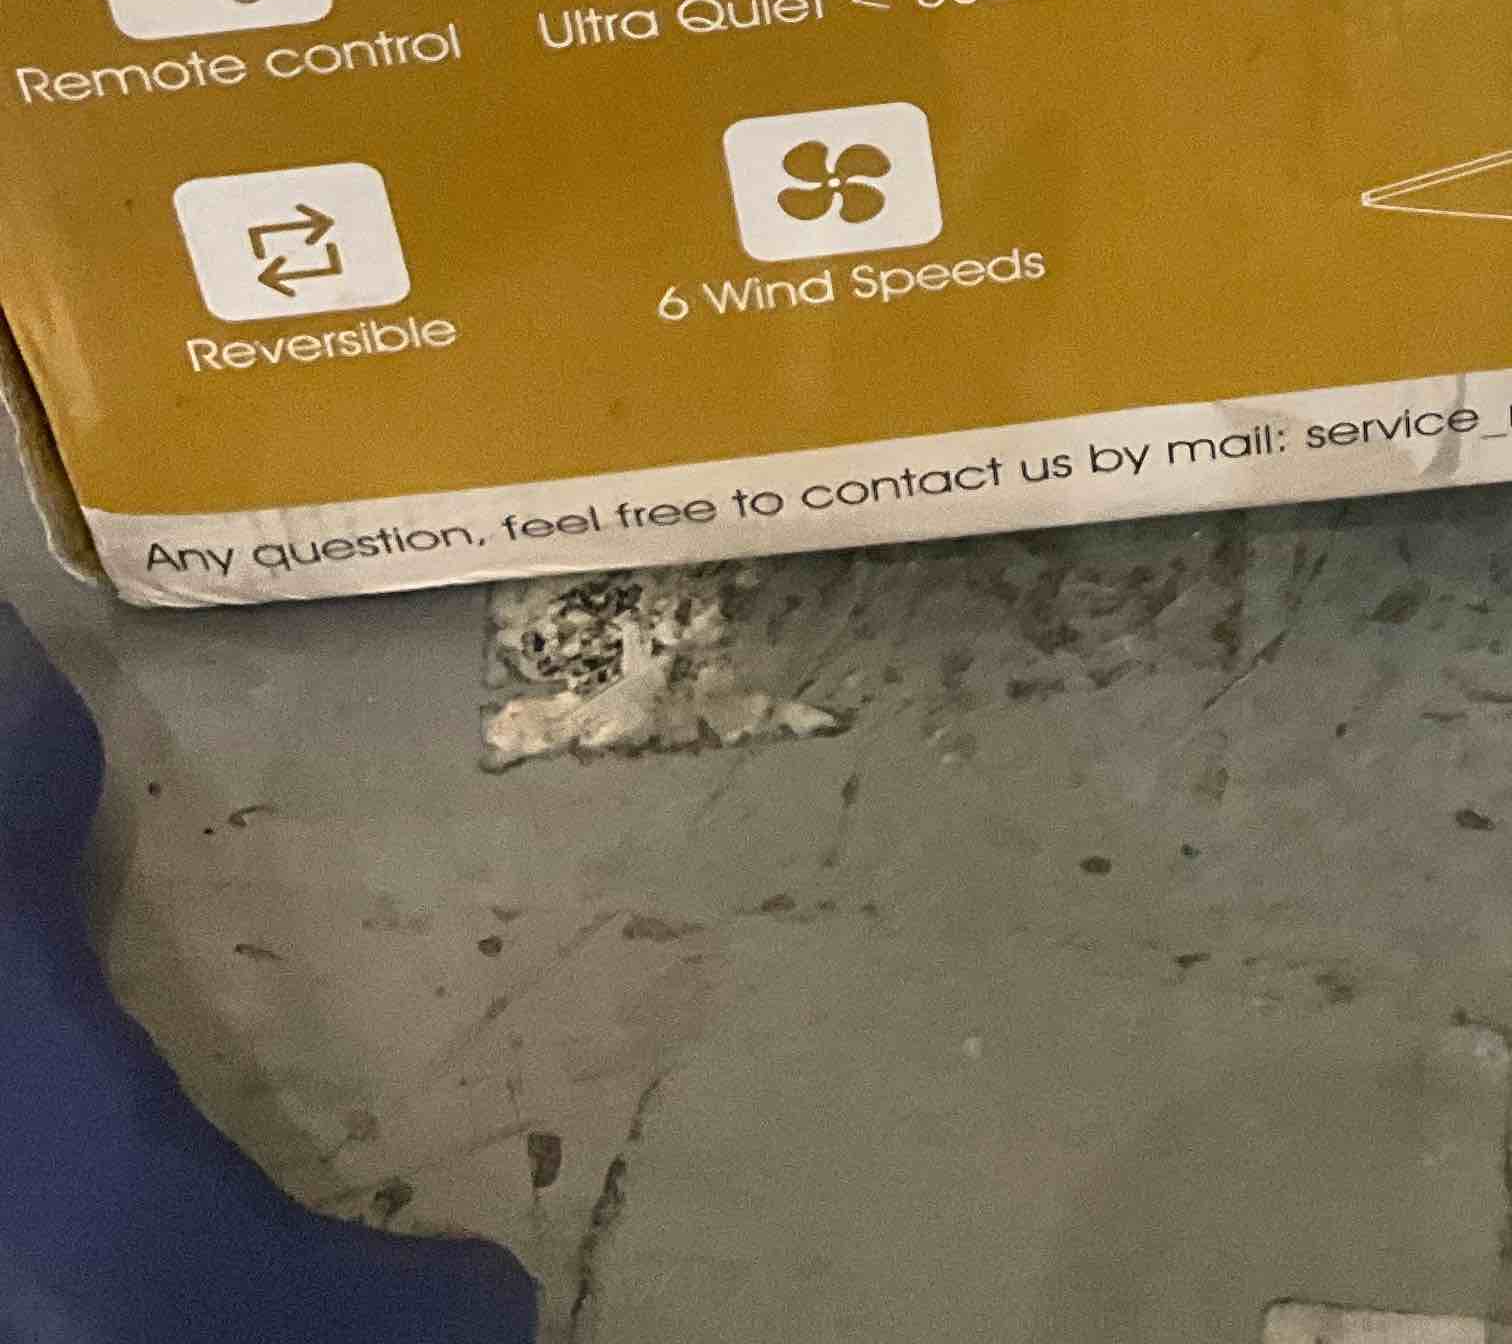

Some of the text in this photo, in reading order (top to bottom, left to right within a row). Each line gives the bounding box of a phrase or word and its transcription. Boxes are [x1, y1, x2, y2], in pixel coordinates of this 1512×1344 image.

[16, 22, 461, 104] Remote control
[538, 8, 660, 50] Ultra
[657, 247, 1047, 321] 6 Wind Speeds
[186, 316, 458, 373] Reversible
[144, 539, 235, 578] Any
[252, 519, 487, 575] question,
[502, 505, 601, 544] feel
[617, 493, 718, 530] free
[732, 486, 783, 518] to
[800, 456, 1003, 511] contact
[1019, 451, 1073, 481] us
[1090, 434, 1150, 481] by
[1167, 421, 1286, 464] mail:
